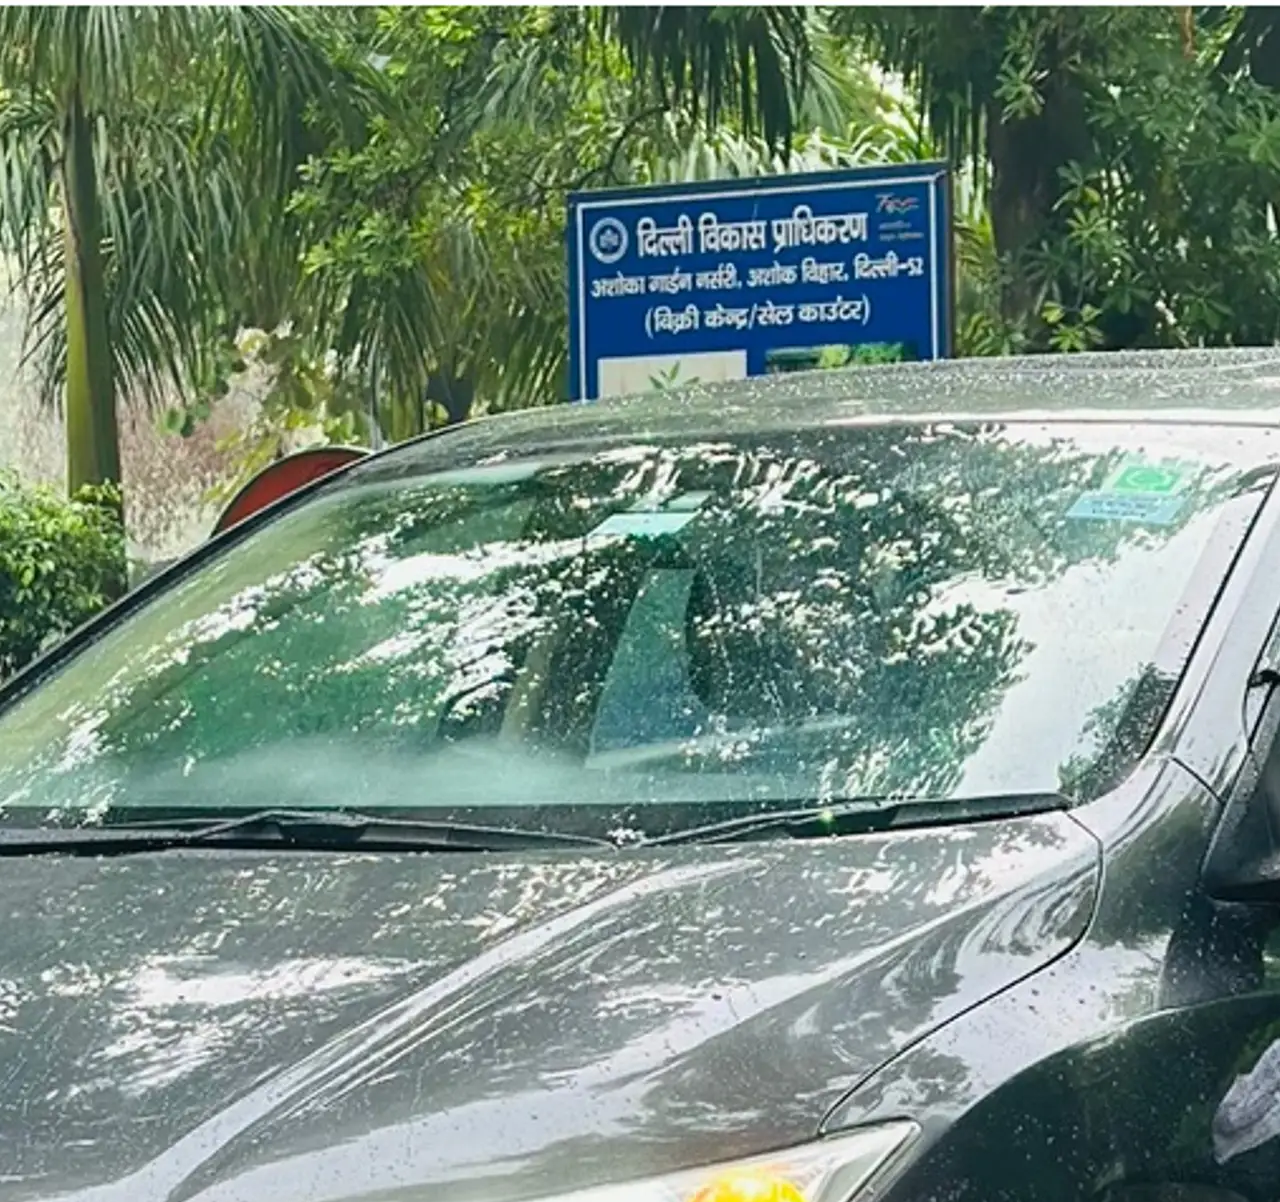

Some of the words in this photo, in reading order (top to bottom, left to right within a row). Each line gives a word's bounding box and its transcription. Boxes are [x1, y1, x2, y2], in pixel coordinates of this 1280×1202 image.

[637, 213, 694, 258] दिल्ली
[698, 211, 767, 254] विकास
[771, 204, 869, 254] प्राधिकरण
[590, 270, 646, 298] अशोका
[648, 265, 693, 295] गार्डन
[746, 260, 798, 288] अशोक
